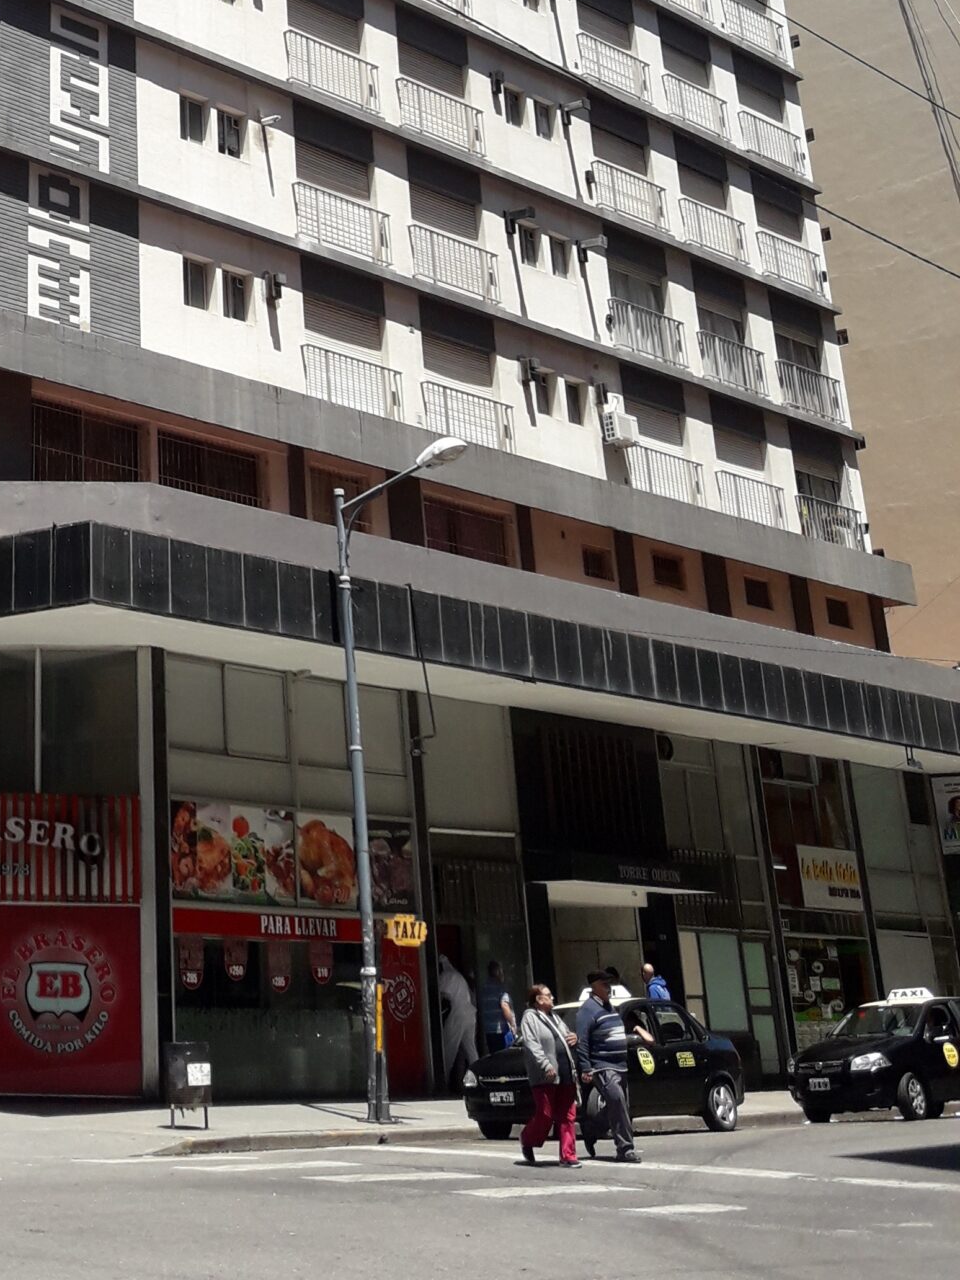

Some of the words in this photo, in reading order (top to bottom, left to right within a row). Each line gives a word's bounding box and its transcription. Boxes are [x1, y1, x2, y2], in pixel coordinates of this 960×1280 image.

[618, 864, 648, 880] TORRE
[260, 914, 291, 935] PARA
[294, 916, 337, 937] LLEVAR
[394, 920, 422, 939] TAXI
[1, 967, 20, 1000] EL
[15, 928, 116, 1003] BRASERO
[37, 971, 82, 998] EB
[892, 989, 923, 997] TAXI
[9, 1010, 52, 1052] COMIDA
[57, 1039, 83, 1053] POR
[84, 1011, 109, 1043] KILO
